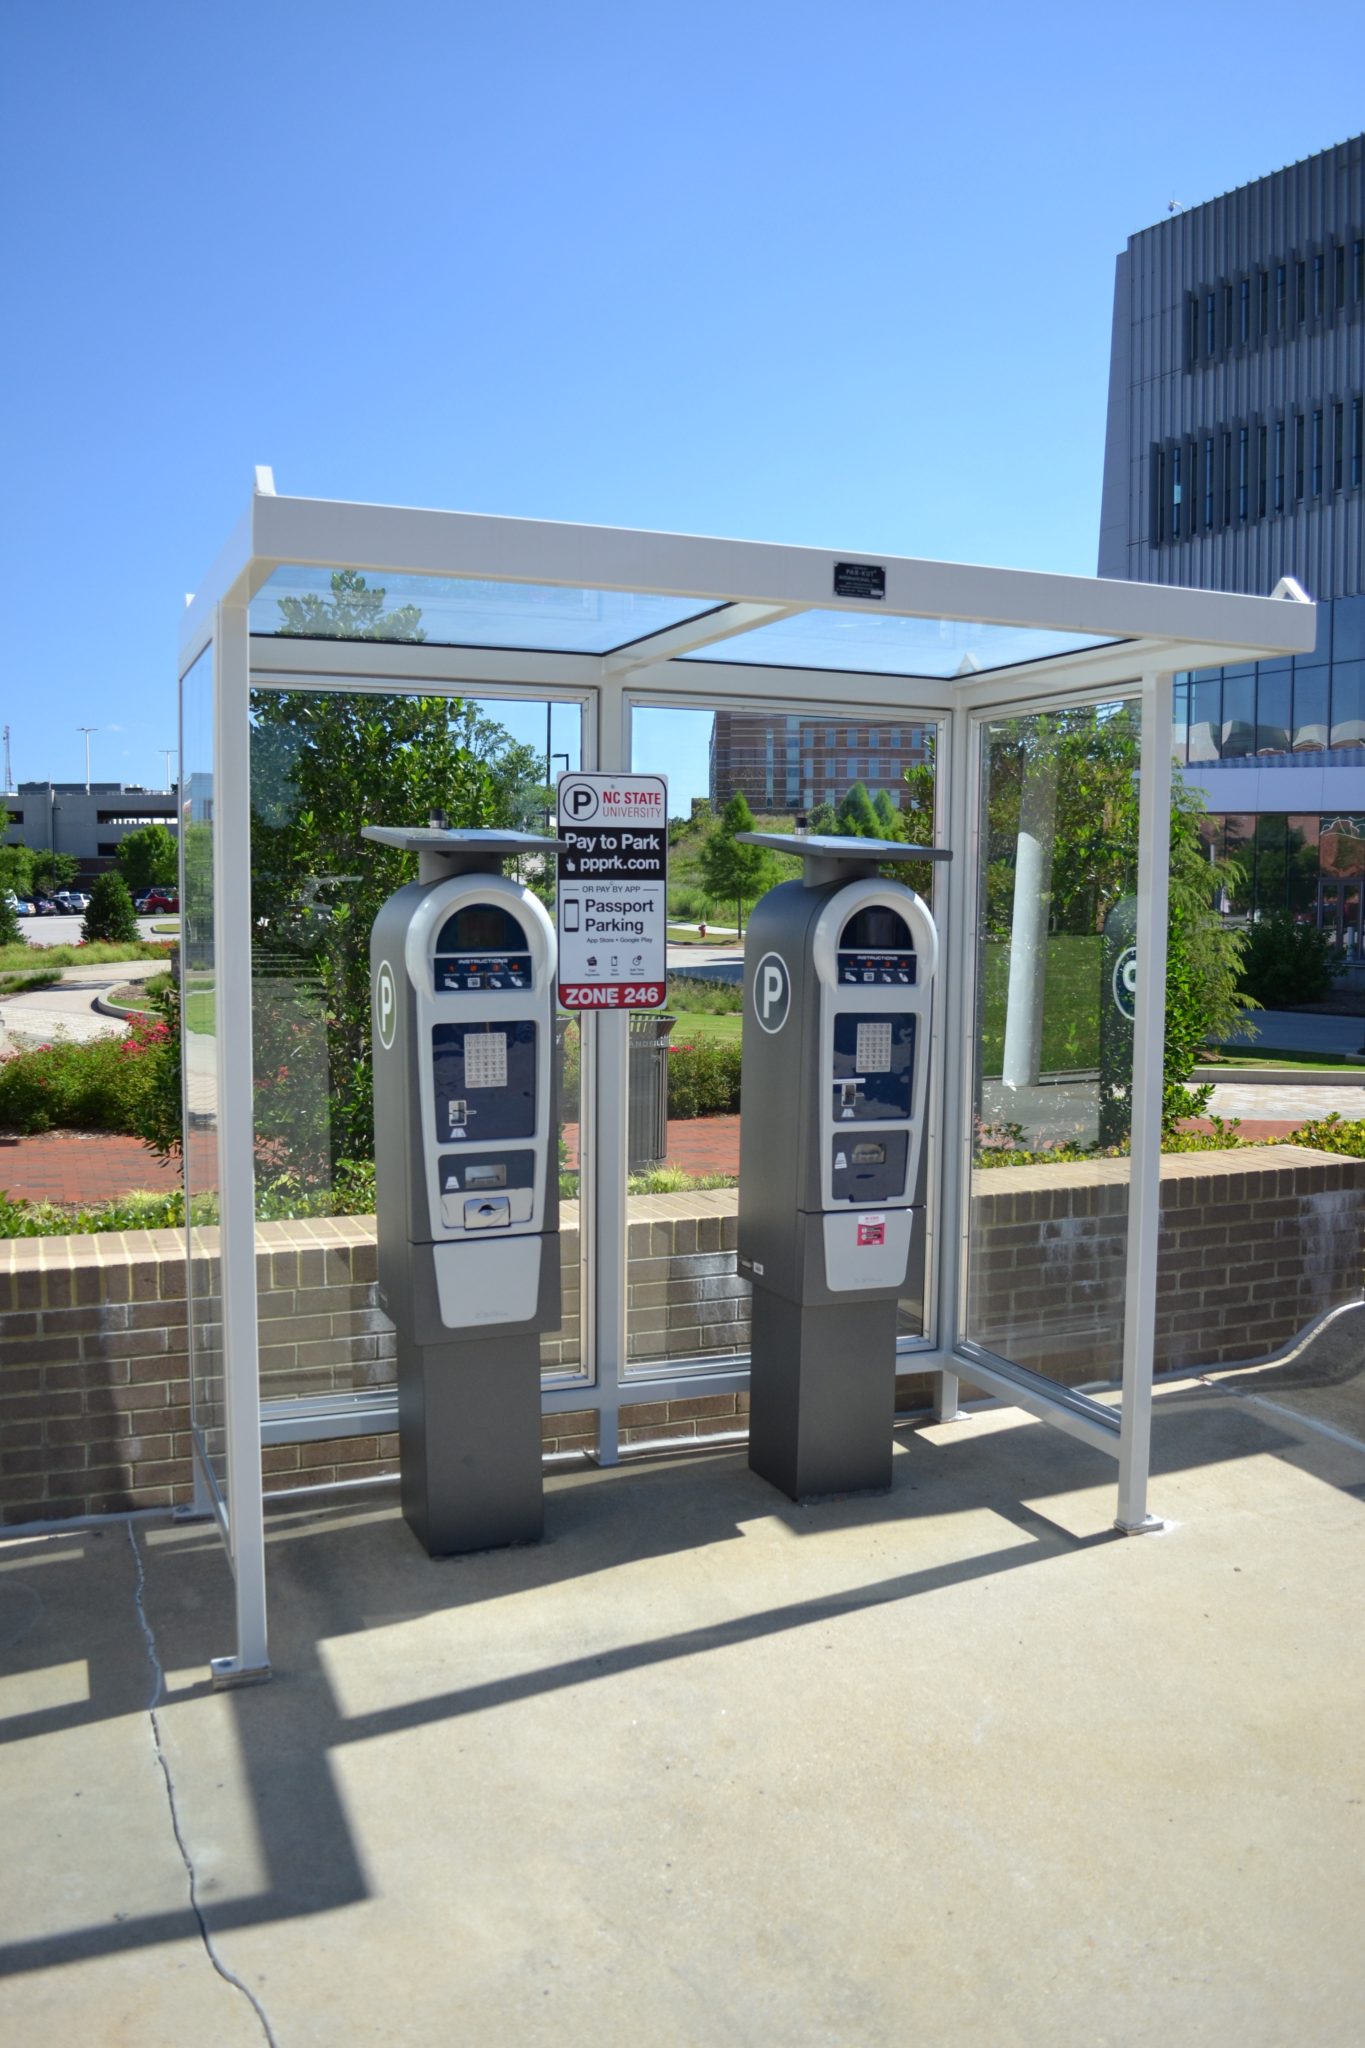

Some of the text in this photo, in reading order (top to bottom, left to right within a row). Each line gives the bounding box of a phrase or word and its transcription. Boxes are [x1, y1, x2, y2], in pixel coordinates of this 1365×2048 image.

[572, 790, 592, 815] P
[603, 791, 662, 805] NC STATE
[602, 806, 662, 818] UNIVERSITY
[565, 832, 660, 852] Pay to Park
[580, 855, 660, 873] ppprk.com
[585, 899, 655, 915] Passport
[585, 919, 644, 935] Parking
[620, 936, 639, 944] Google
[640, 936, 653, 944] Play
[565, 987, 659, 1005] ZONE 246
[763, 966, 783, 1018] P
[381, 975, 392, 1032] P
